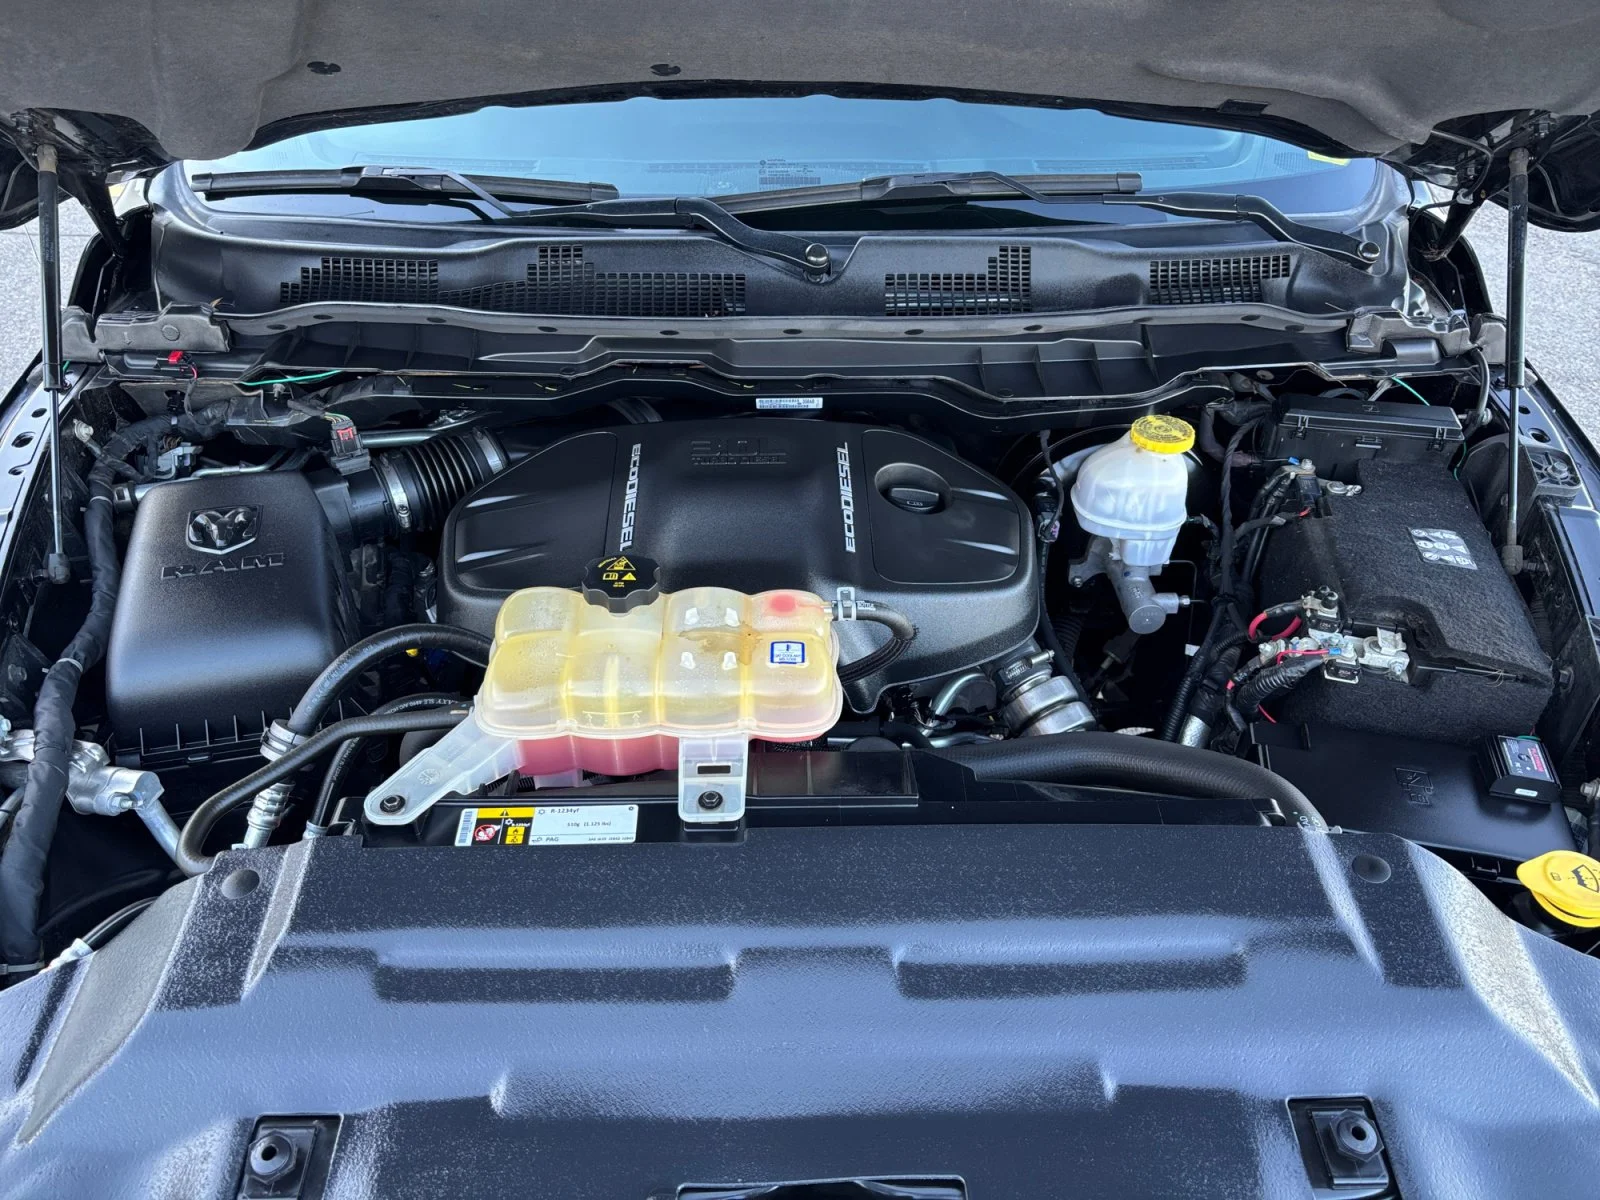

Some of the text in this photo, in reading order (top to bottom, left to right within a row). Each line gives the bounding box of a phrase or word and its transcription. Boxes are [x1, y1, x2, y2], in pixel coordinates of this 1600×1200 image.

[620, 443, 641, 552] ECODIESEL
[837, 441, 856, 553] ECODIESEL
[161, 552, 284, 580] RAM
[550, 807, 580, 815] R-1234yf
